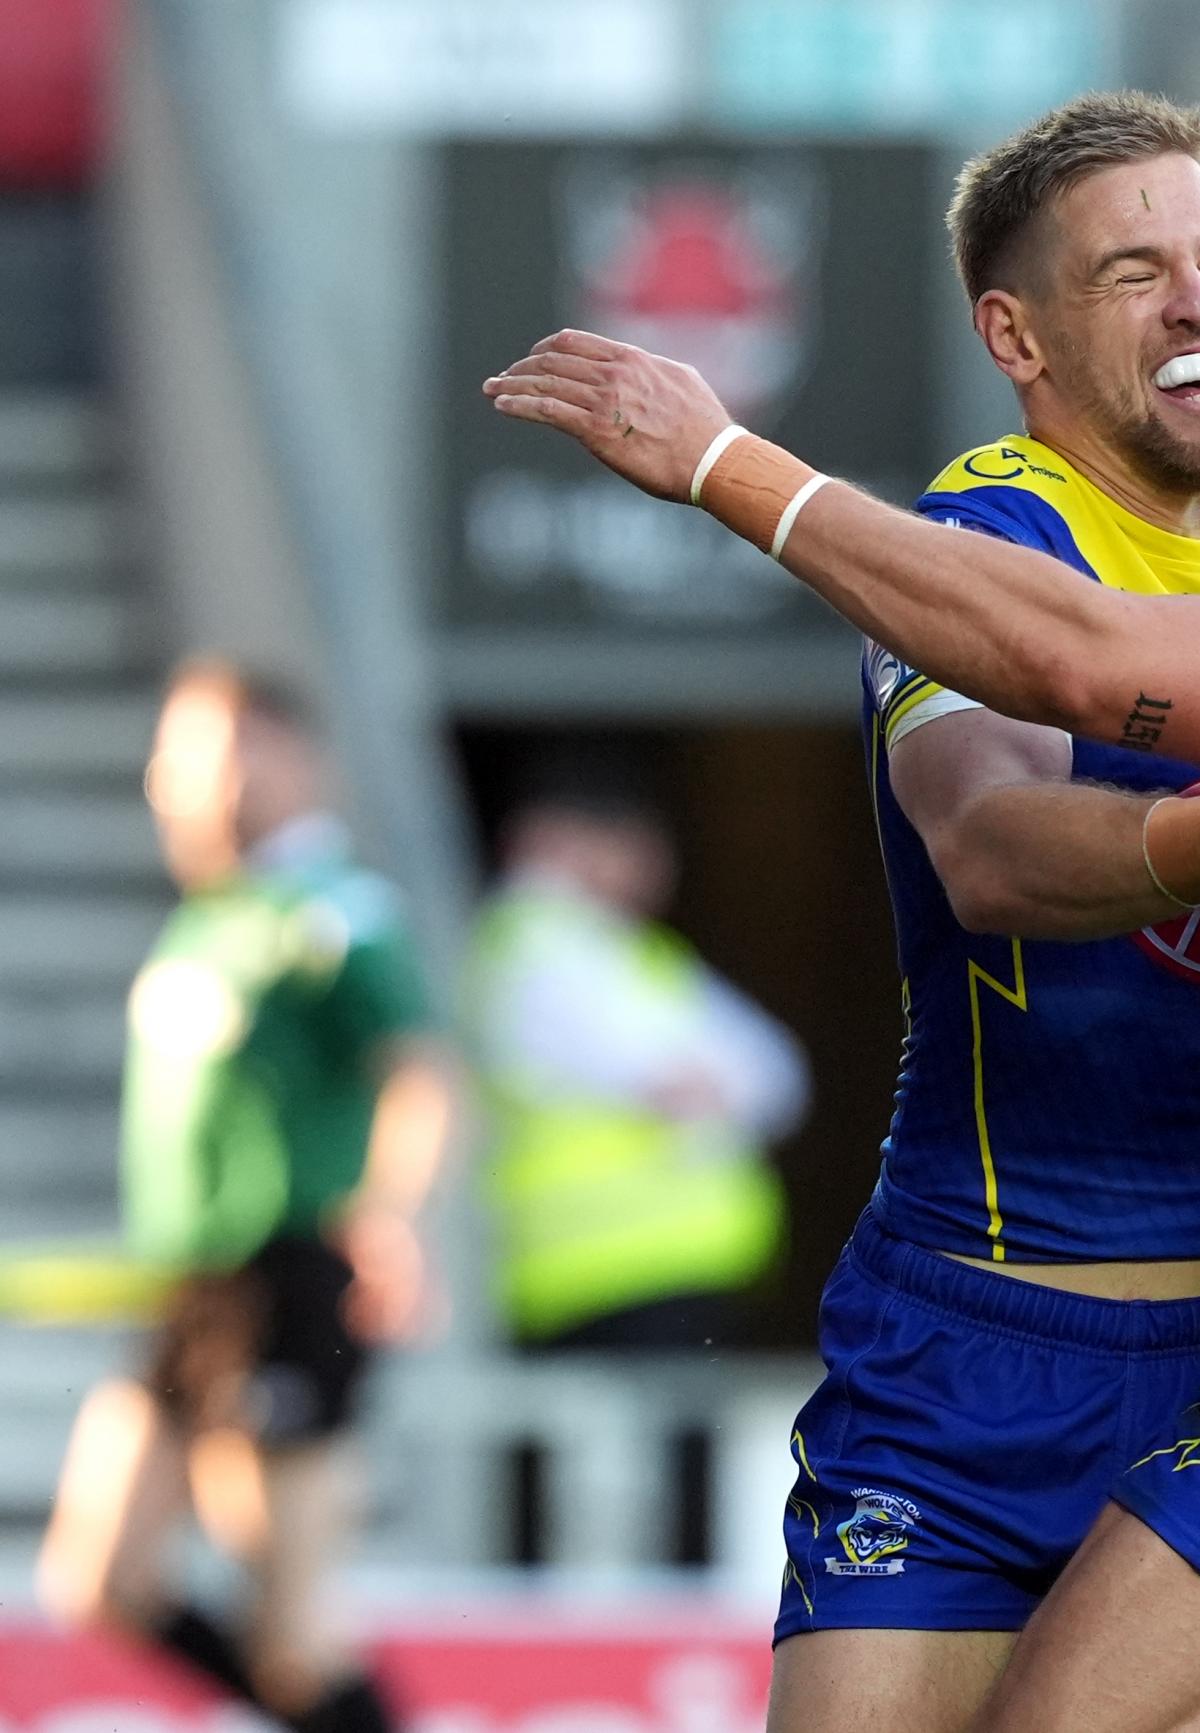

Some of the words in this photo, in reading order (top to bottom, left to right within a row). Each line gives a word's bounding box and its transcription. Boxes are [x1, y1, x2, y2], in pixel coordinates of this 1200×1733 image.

[964, 448, 1028, 480] C4
[1028, 464, 1067, 483] Projects
[859, 1565, 888, 1574] WIRE
